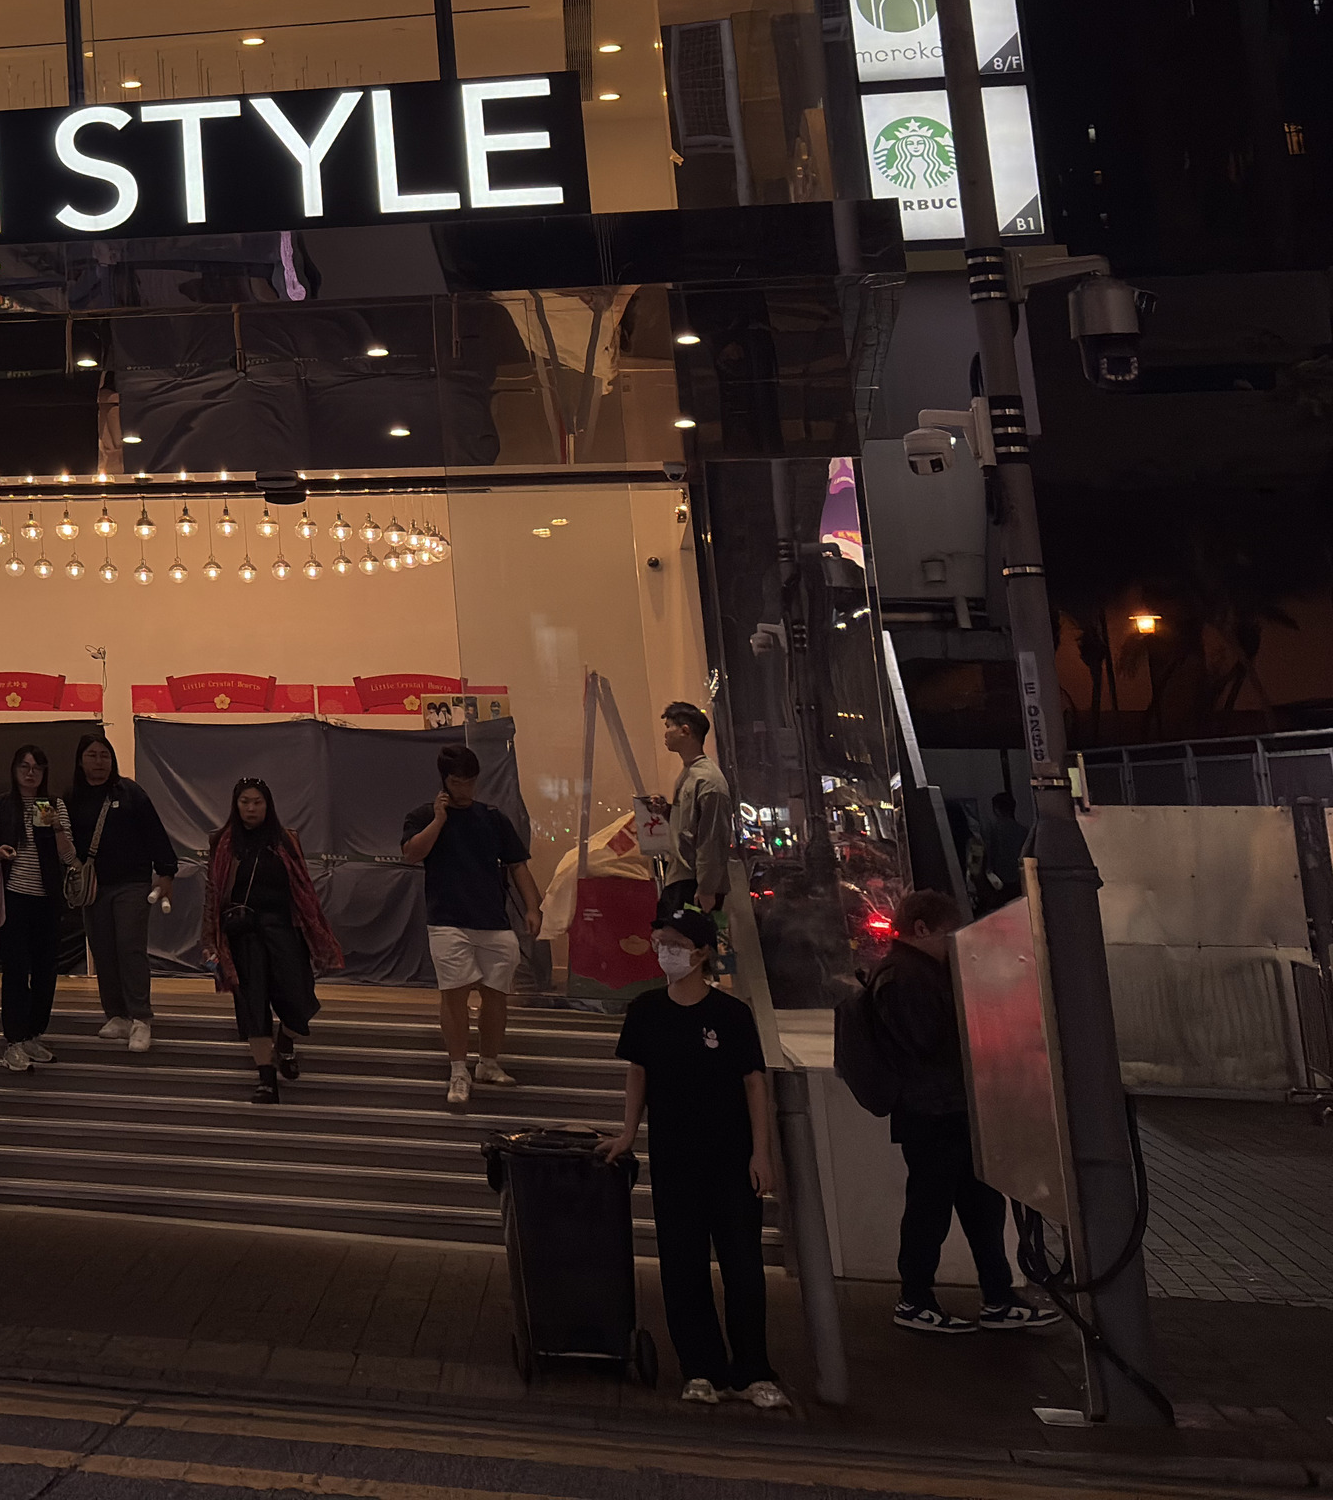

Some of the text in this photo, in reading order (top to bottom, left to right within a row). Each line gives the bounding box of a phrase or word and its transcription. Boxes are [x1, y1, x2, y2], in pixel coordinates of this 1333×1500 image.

[993, 55, 1021, 72] 8/F
[55, 78, 565, 233] STYLE
[902, 197, 958, 211] RBUC
[1016, 217, 1035, 231] B1
[182, 681, 205, 691] Little
[207, 680, 235, 688] Crystal
[370, 683, 395, 692] Little
